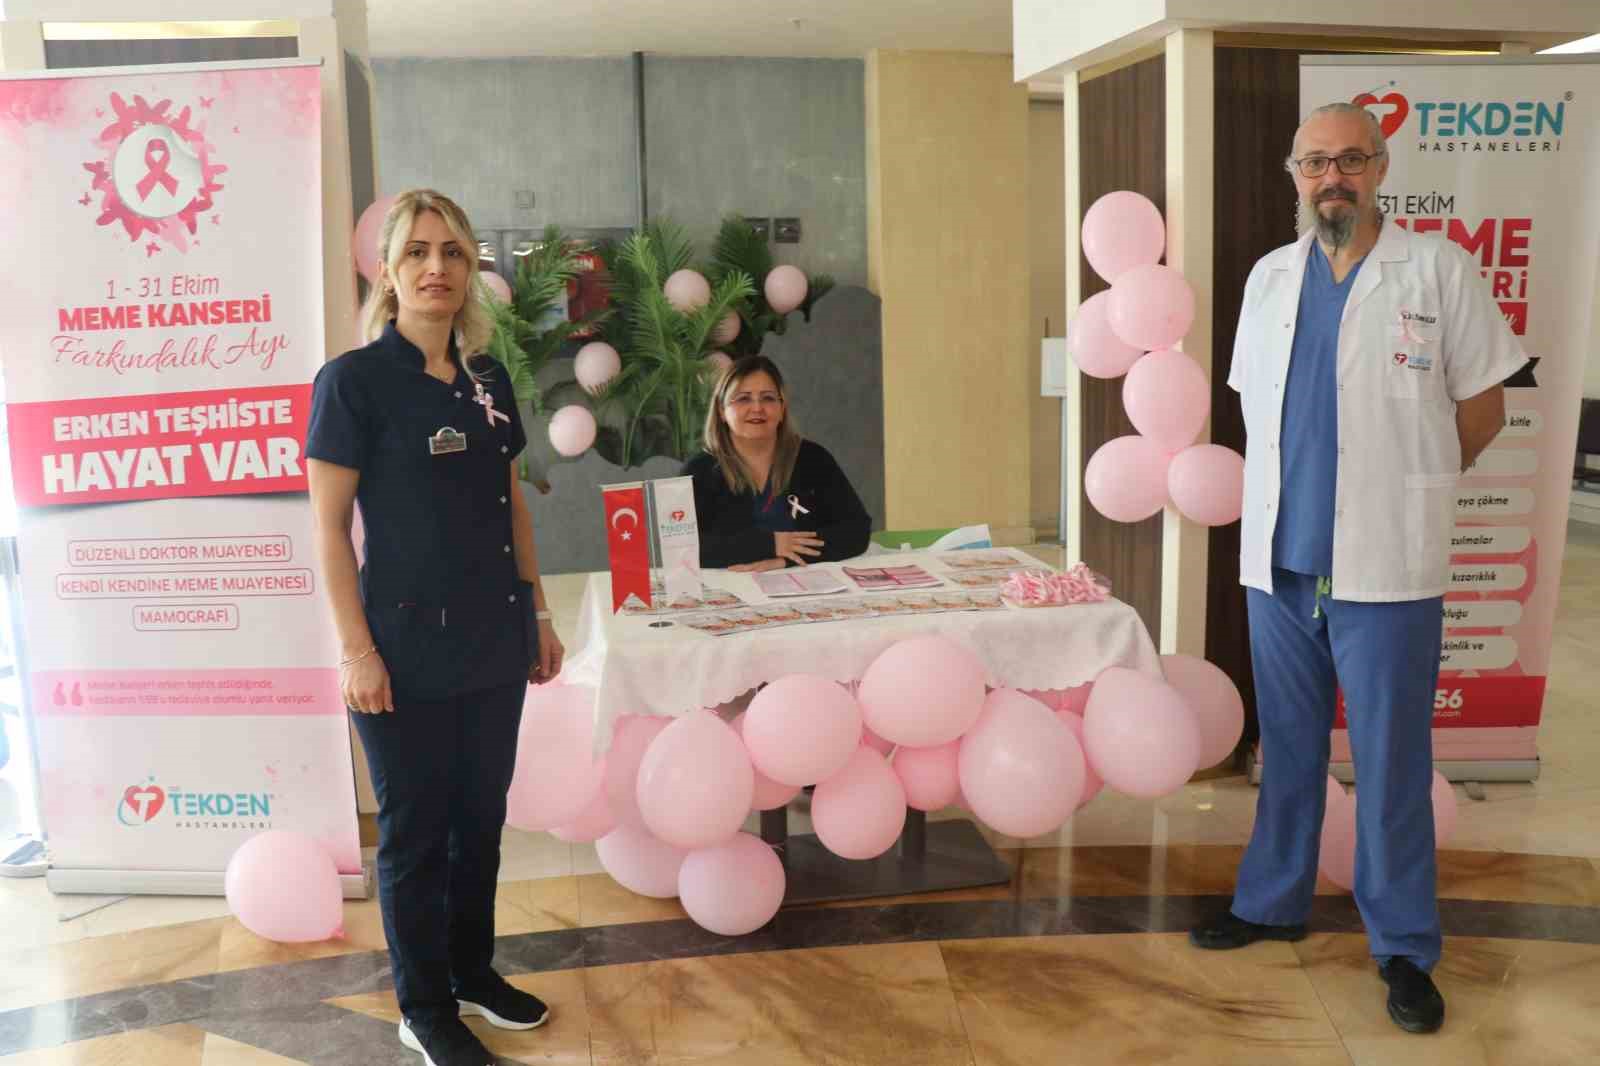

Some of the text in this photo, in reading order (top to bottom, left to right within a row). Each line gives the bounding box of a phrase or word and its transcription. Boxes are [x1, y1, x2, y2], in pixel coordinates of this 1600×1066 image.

[1415, 102, 1565, 137] TEKDEN
[1419, 142, 1561, 152] HASTANELERİ
[1405, 191, 1455, 214] EKİM
[1394, 218, 1532, 267] ME
[106, 279, 115, 300] 1
[139, 277, 162, 298] 31
[171, 274, 220, 296] Ekim
[1480, 270, 1528, 299] Rİ
[58, 294, 272, 332] MEME KANSERİ
[50, 327, 290, 375] Farkındalık Ayı
[53, 398, 293, 441] ERKEN TEŞHİSTE
[1510, 415, 1531, 427] kitle
[41, 437, 303, 494] HAYAT VAR
[1457, 498, 1475, 508] eya
[75, 543, 286, 562] DÜZENLİ DOKTOR MUAYENESİ
[1451, 535, 1494, 546] zulmalar
[61, 573, 307, 593] KENDİ KENDİNE MEME MUAYENESİ
[140, 608, 229, 625] MAMOGRAFİ
[1440, 640, 1470, 651] kinlik
[168, 792, 271, 817] TEKDEN
